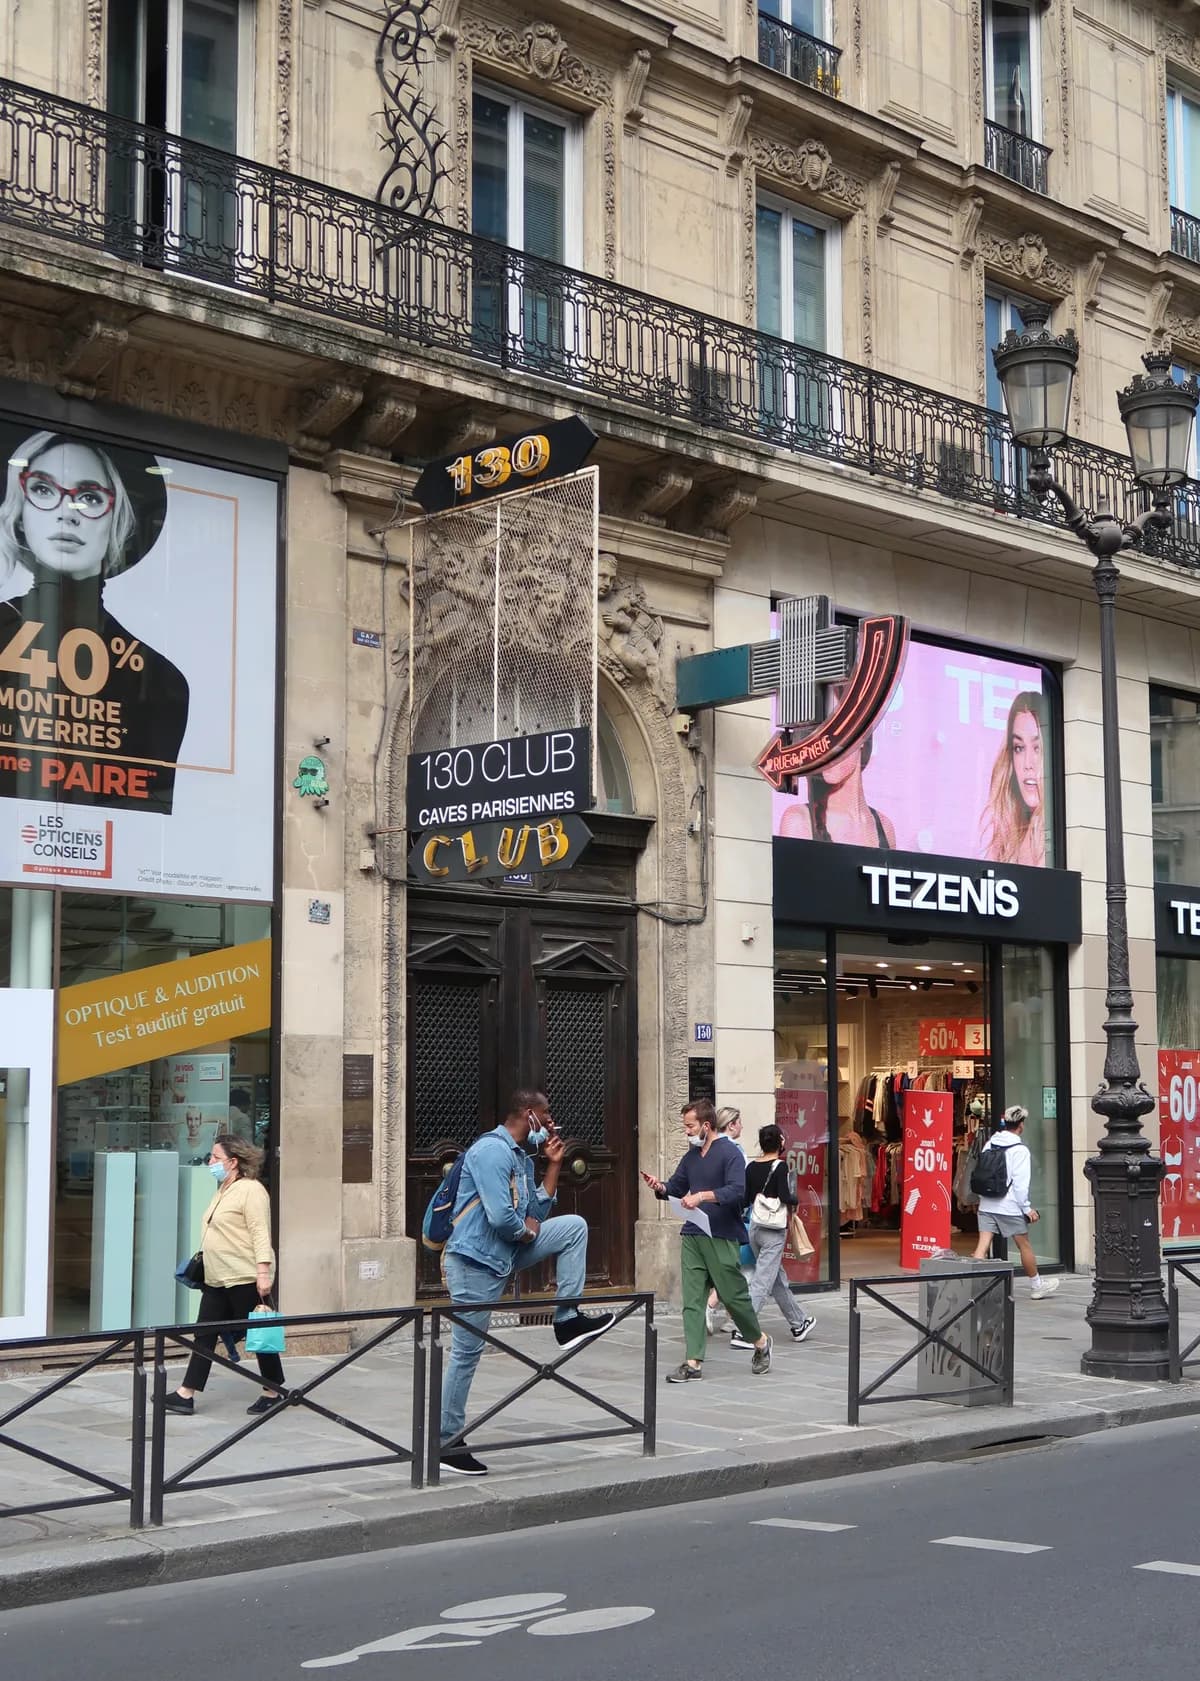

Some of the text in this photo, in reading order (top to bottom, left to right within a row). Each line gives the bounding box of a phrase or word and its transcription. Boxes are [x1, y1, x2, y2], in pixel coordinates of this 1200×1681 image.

[445, 434, 550, 496] 130
[944, 664, 1042, 731] TE
[0, 723, 13, 736] u
[420, 732, 575, 790] 130 CLUB
[39, 815, 64, 828] LES
[418, 790, 575, 826] CAVES PARISIENNES
[33, 843, 98, 860] CONSEILS
[423, 818, 569, 877] CLUB
[65, 963, 260, 1026] OPTIQUE & AUDITION
[92, 993, 246, 1048] Test auditif gratuit
[697, 1025, 712, 1039] 130
[924, 1027, 958, 1050] -60%
[908, 1147, 948, 1172] -60%
